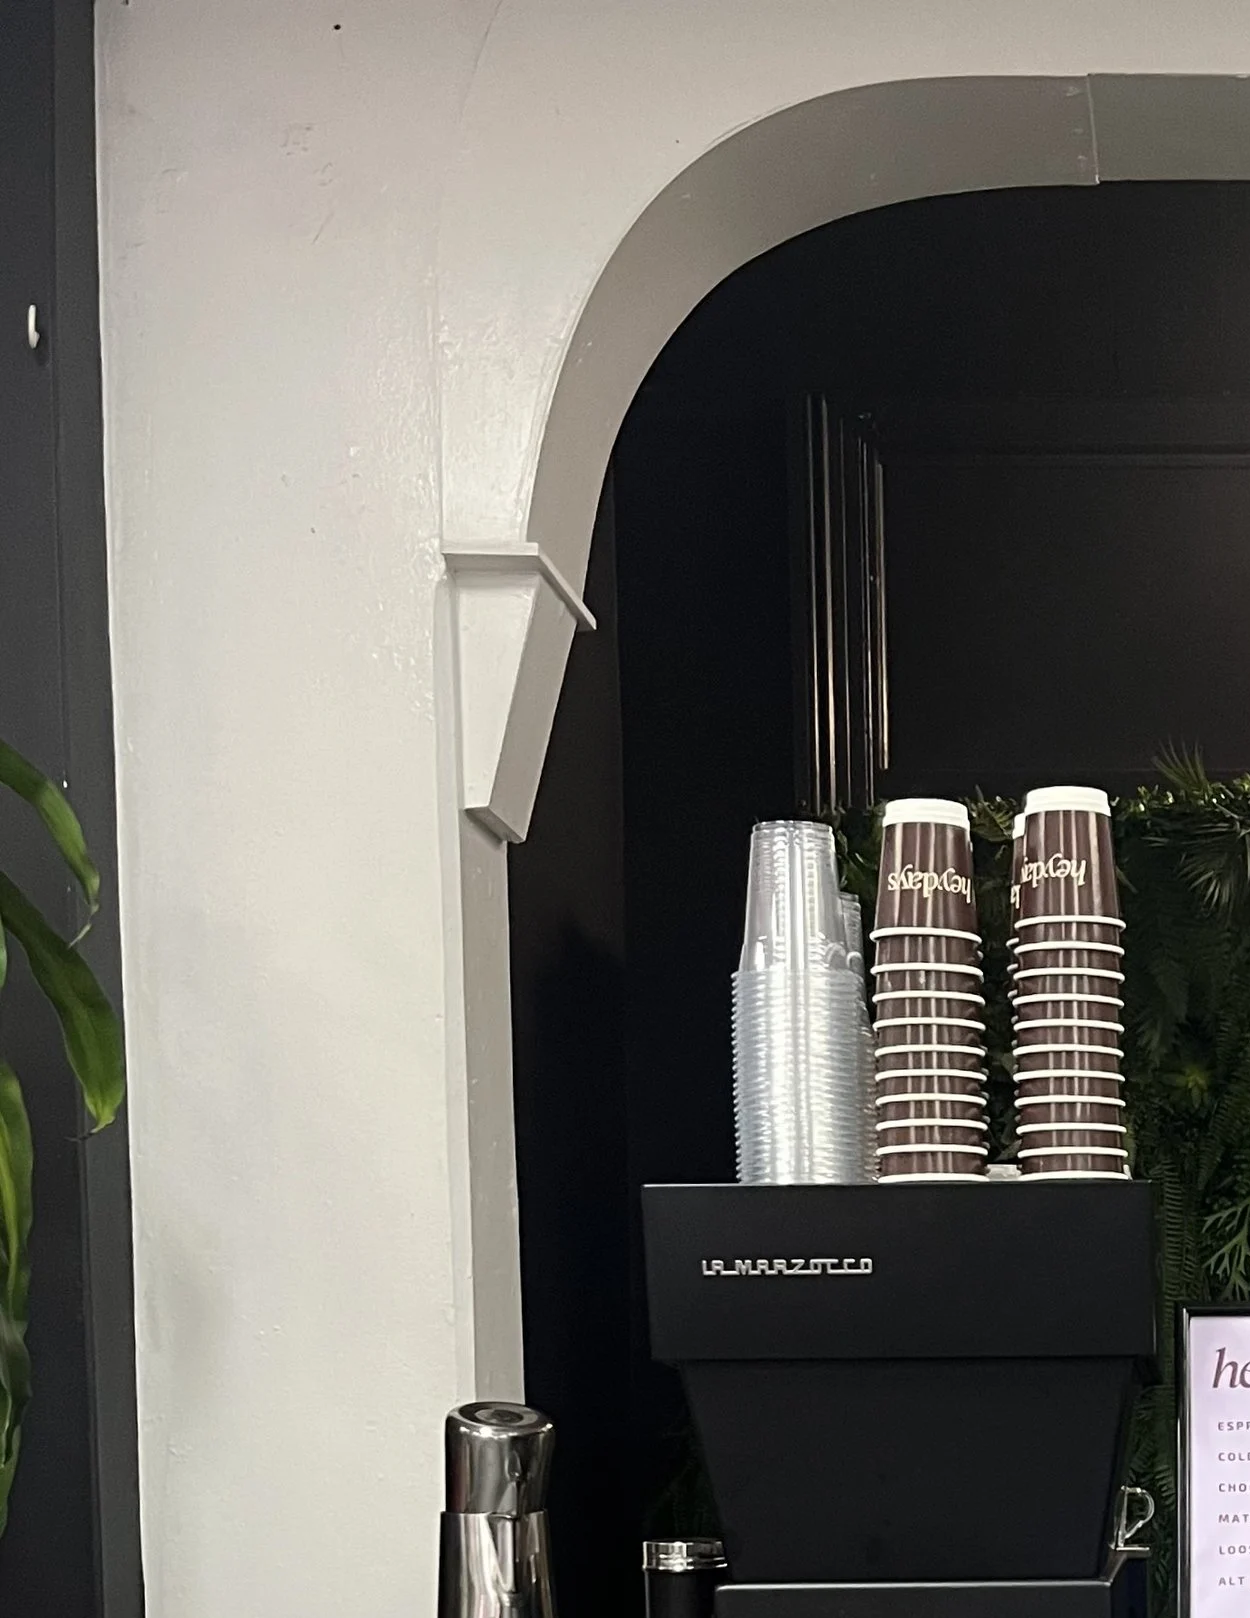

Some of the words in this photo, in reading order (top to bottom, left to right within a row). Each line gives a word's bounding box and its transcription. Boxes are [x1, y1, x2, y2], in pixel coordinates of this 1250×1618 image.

[888, 864, 971, 904] heydays
[702, 1258, 724, 1275] LA
[1218, 1576, 1245, 1586] ALT
